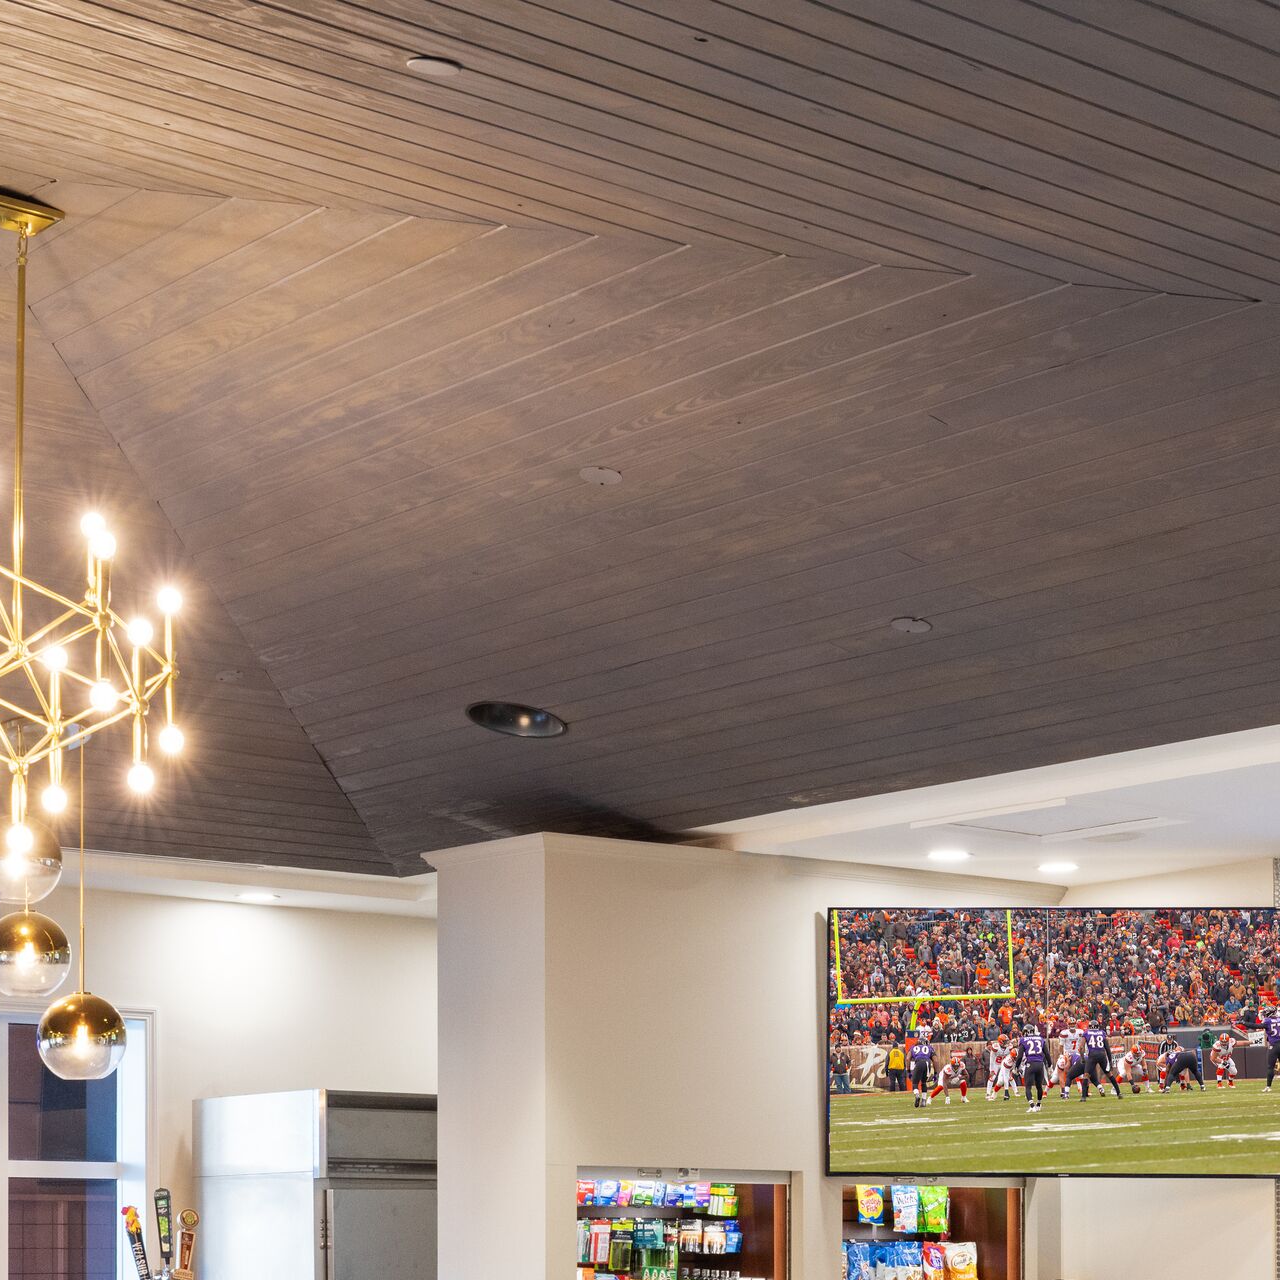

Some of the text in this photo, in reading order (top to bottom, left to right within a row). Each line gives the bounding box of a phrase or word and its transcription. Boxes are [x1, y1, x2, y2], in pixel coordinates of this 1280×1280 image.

[1071, 1040, 1077, 1050] 7
[1088, 1035, 1104, 1048] 48
[914, 1046, 929, 1055] 90
[1028, 1042, 1043, 1055] 23
